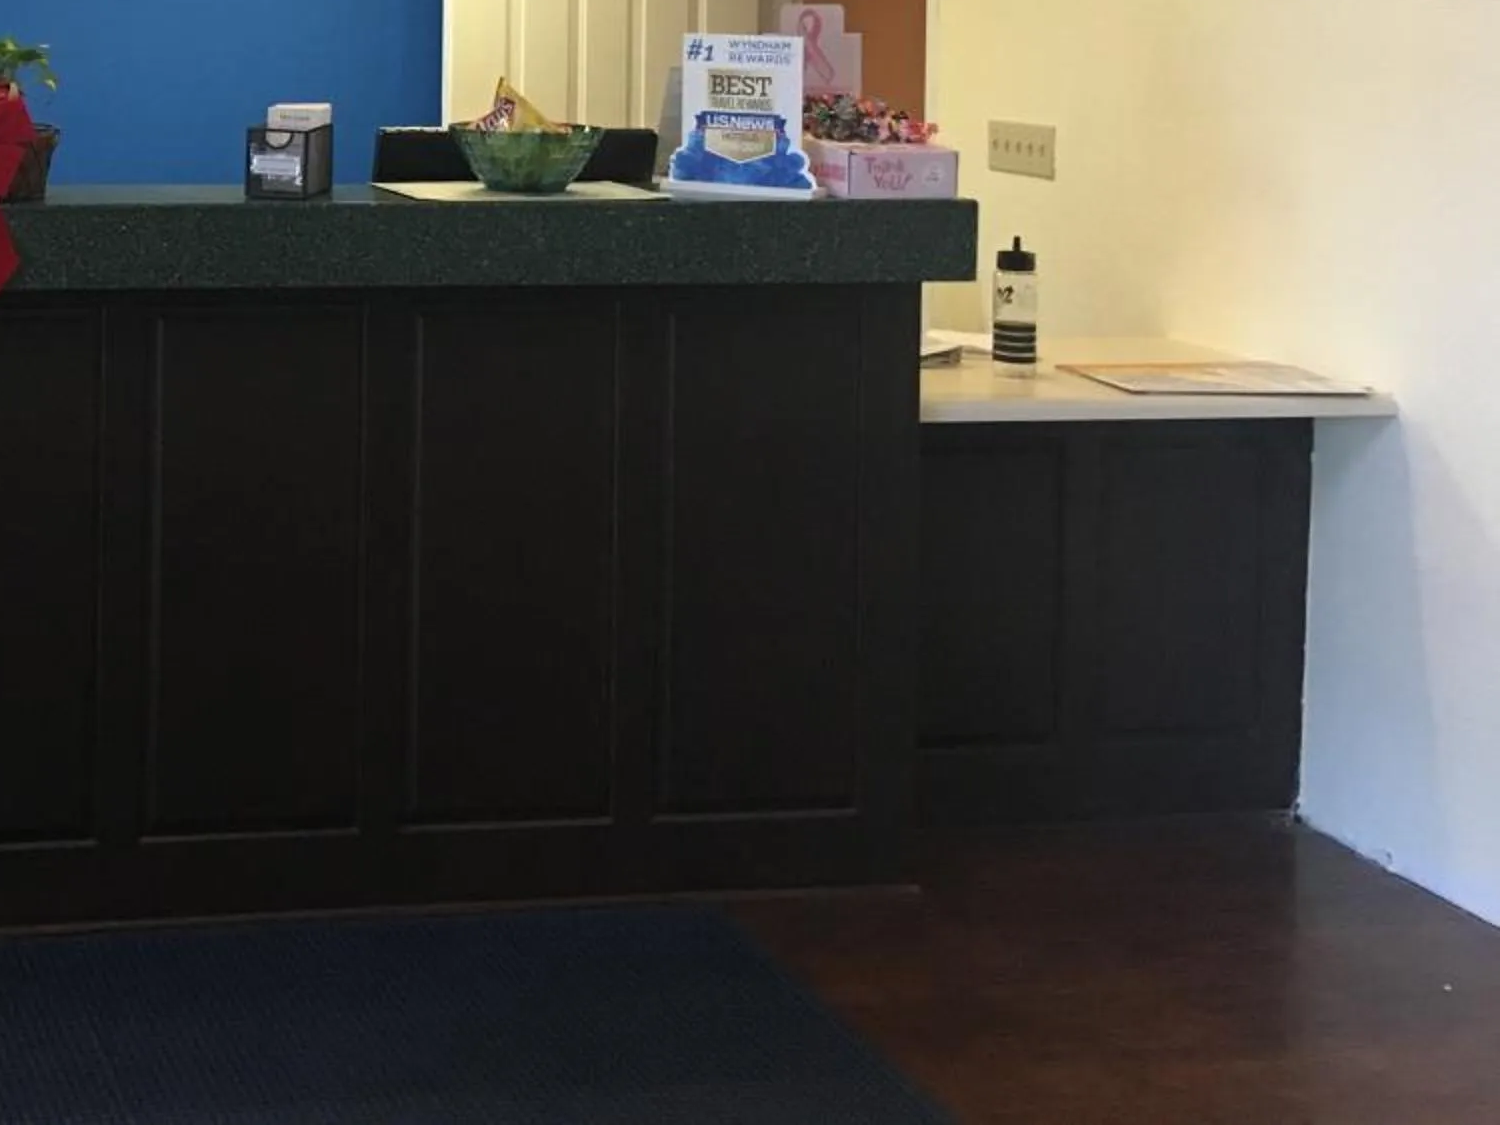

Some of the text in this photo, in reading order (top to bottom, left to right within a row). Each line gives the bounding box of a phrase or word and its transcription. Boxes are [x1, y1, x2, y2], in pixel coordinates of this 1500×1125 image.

[686, 38, 715, 62] #1
[728, 39, 792, 51] WYNDHAM
[728, 52, 792, 65] REWARDS
[710, 74, 773, 98] BEST
